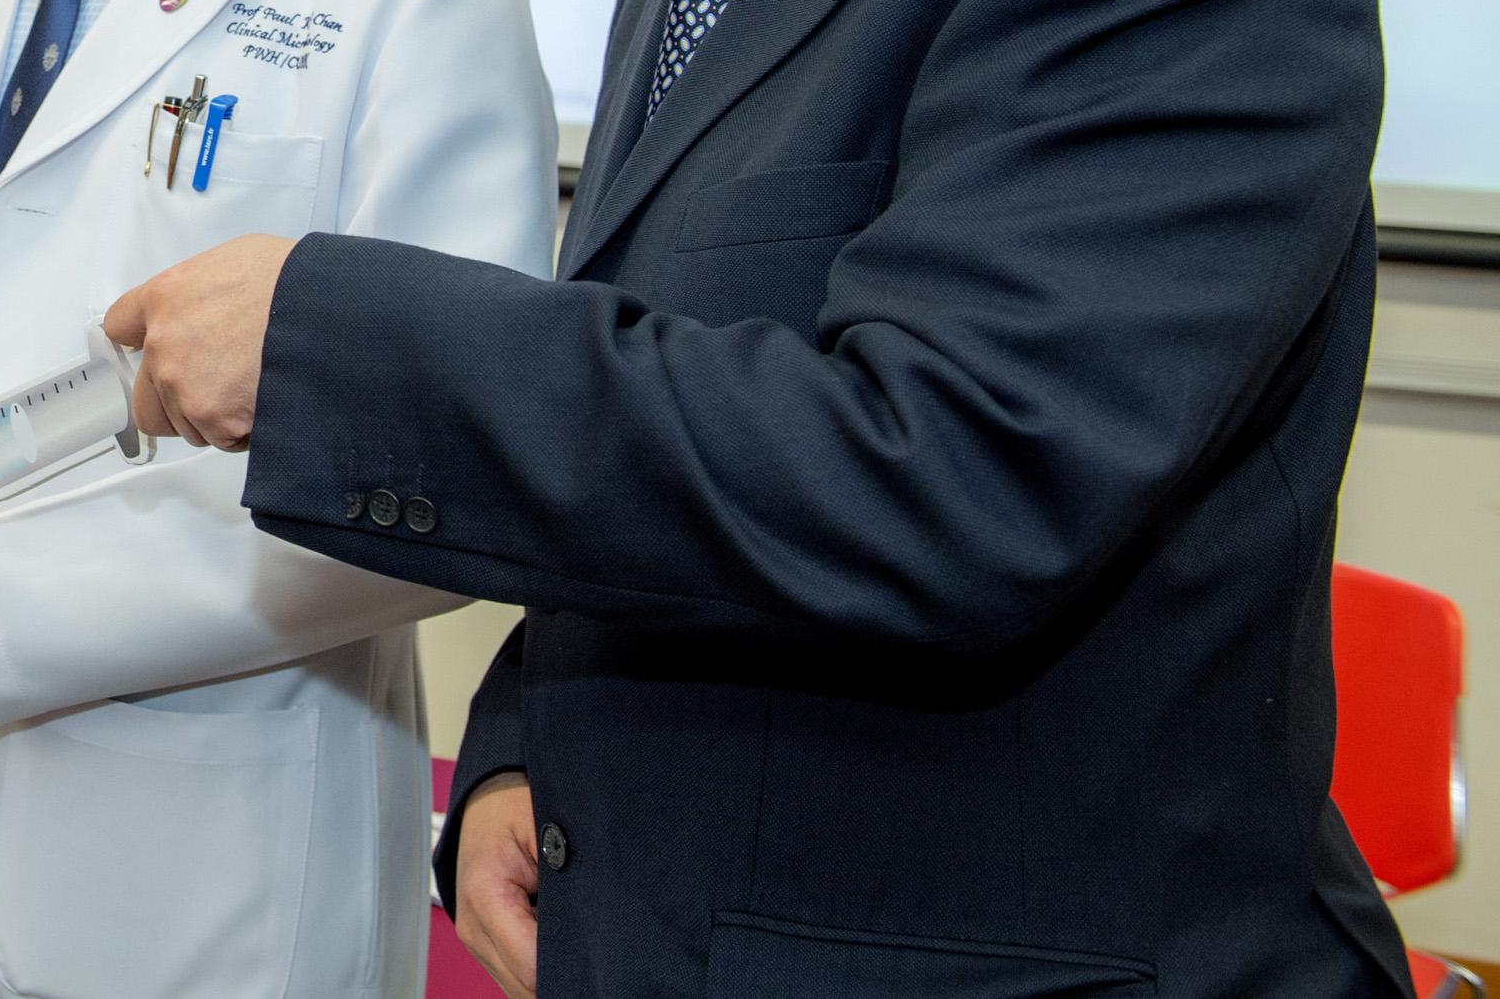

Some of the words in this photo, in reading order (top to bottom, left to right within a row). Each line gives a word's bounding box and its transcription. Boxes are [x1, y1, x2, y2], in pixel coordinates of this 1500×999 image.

[232, 2, 263, 21] Prof
[263, 7, 301, 26] Paul
[312, 13, 344, 32] Chan
[226, 22, 278, 41] Clinical
